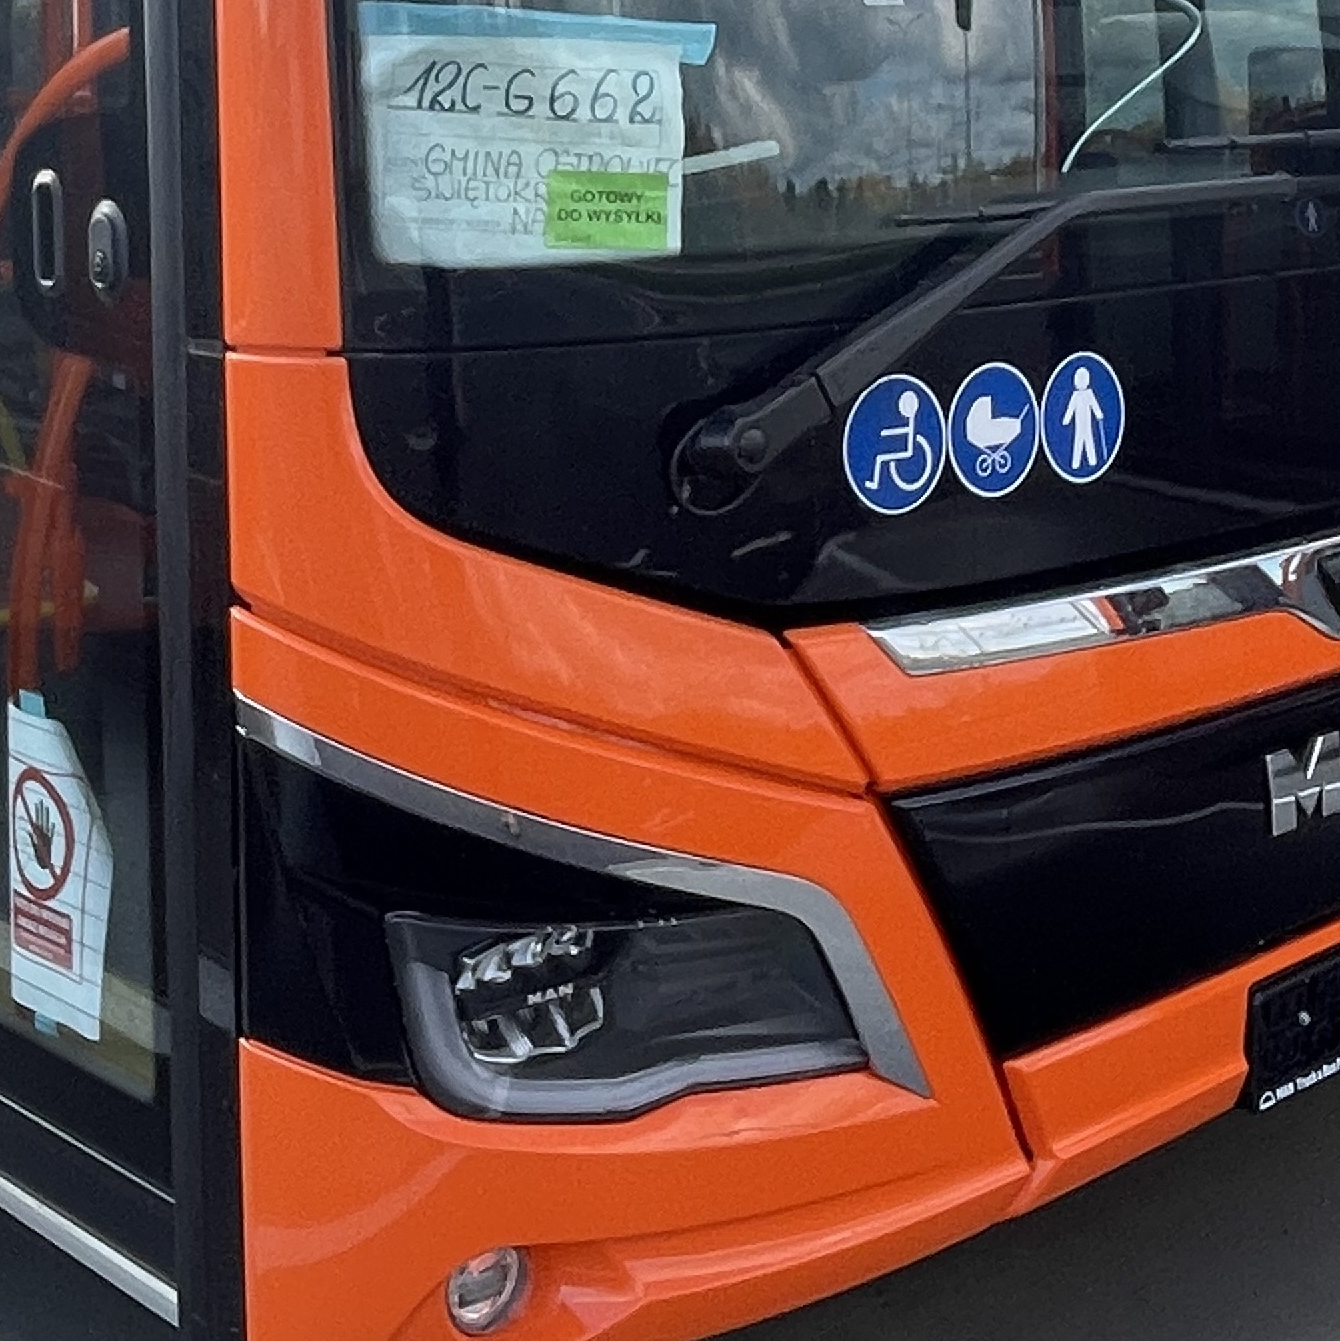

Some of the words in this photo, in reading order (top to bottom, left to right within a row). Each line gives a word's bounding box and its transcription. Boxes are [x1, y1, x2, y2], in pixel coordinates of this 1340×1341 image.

[424, 143, 524, 179] GMINA
[410, 173, 548, 209] ŚWIĘTOKR
[570, 189, 645, 203] GOTOWY
[556, 208, 582, 222] DO
[526, 982, 574, 1006] MAN
